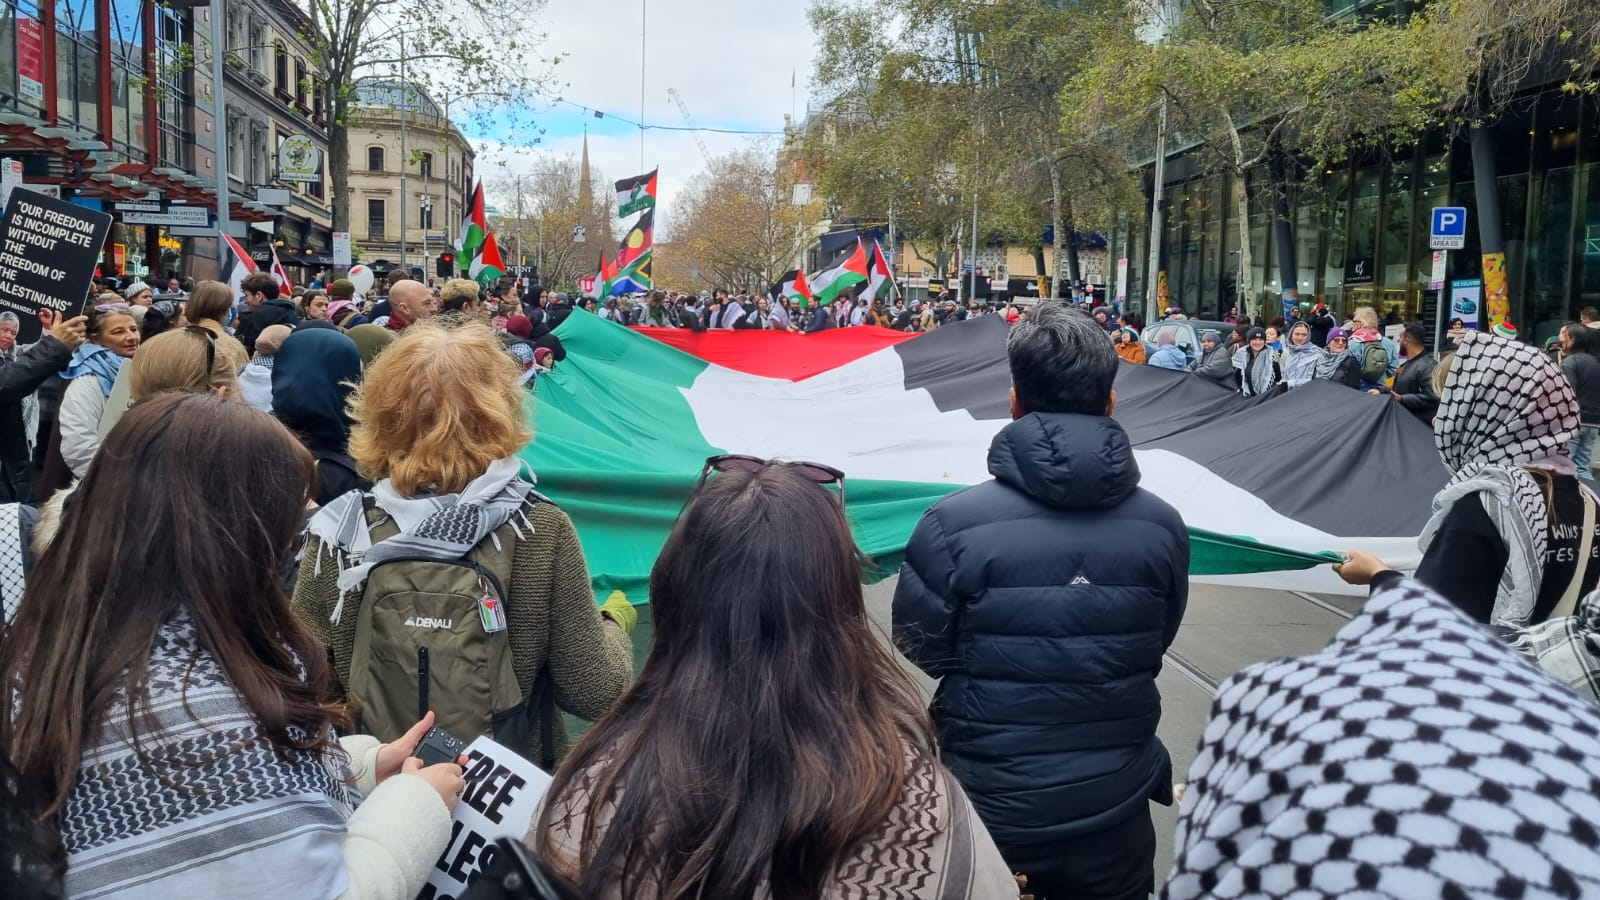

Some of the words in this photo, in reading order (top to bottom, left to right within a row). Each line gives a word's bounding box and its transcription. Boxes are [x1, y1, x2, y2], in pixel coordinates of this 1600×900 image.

[11, 213, 23, 226] IS
[24, 217, 92, 248] INCOMPLETE
[44, 209, 95, 235] FREEDOM
[1440, 212, 1457, 232] P
[4, 239, 26, 255] THE
[8, 226, 57, 251] WITHOUT
[0, 251, 50, 278] FREEDOM
[50, 270, 67, 282] OF
[0, 265, 18, 281] THE
[0, 281, 72, 312] ALESTINIANS”
[11, 302, 36, 316] MANDELA
[416, 617, 452, 629] DENALI
